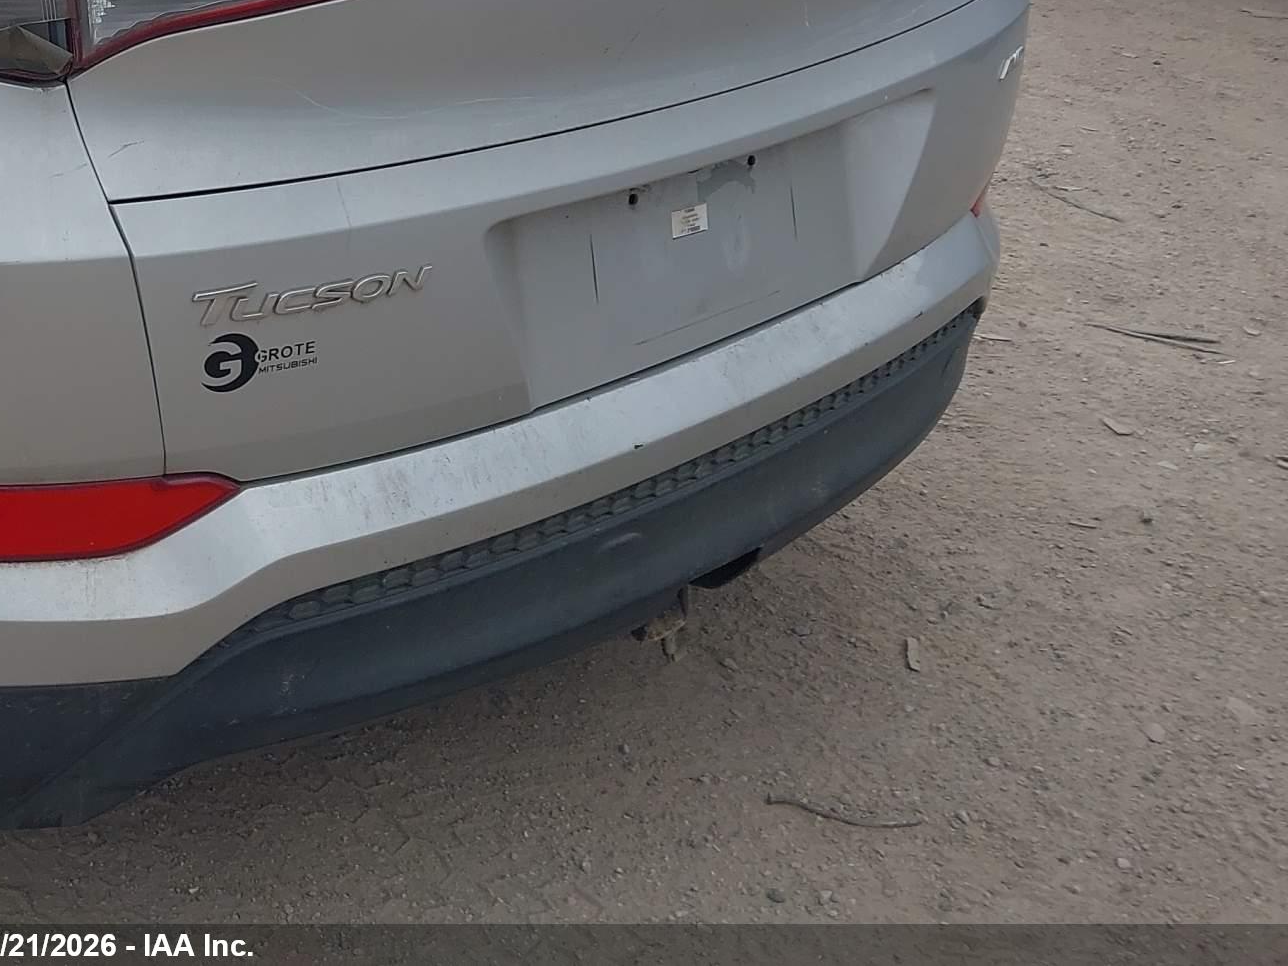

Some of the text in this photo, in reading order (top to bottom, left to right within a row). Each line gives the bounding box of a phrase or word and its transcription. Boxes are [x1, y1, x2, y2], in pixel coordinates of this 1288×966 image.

[192, 264, 433, 327] TUCSON
[257, 340, 316, 363] GROTE
[258, 356, 318, 374] MITSUBISHI
